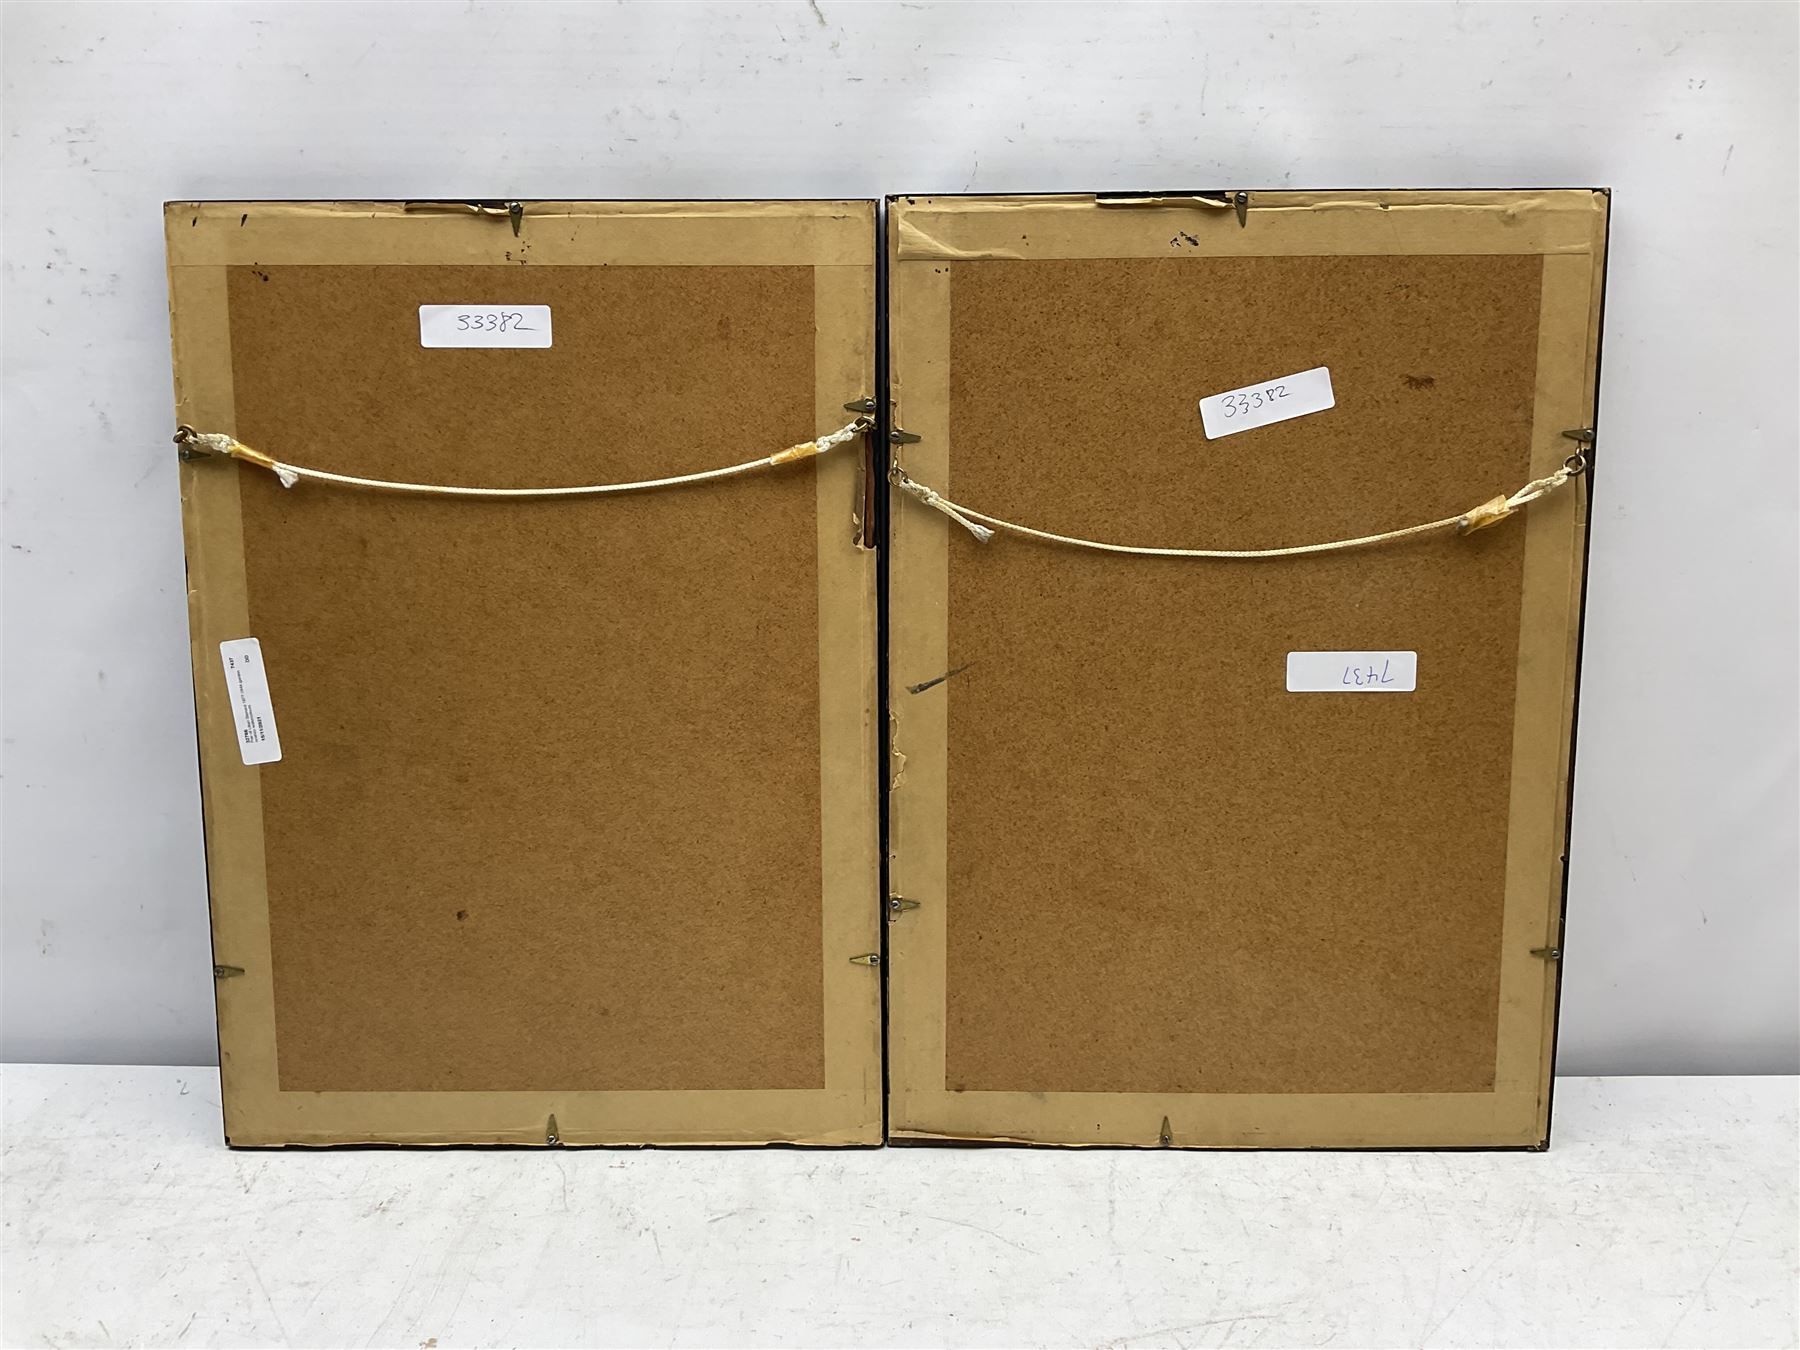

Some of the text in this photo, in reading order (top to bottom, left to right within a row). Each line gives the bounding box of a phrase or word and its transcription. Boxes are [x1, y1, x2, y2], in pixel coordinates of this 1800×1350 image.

[457, 312, 539, 332] 33382
[1221, 385, 1293, 418] 33382
[1342, 659, 1394, 686] 7437
